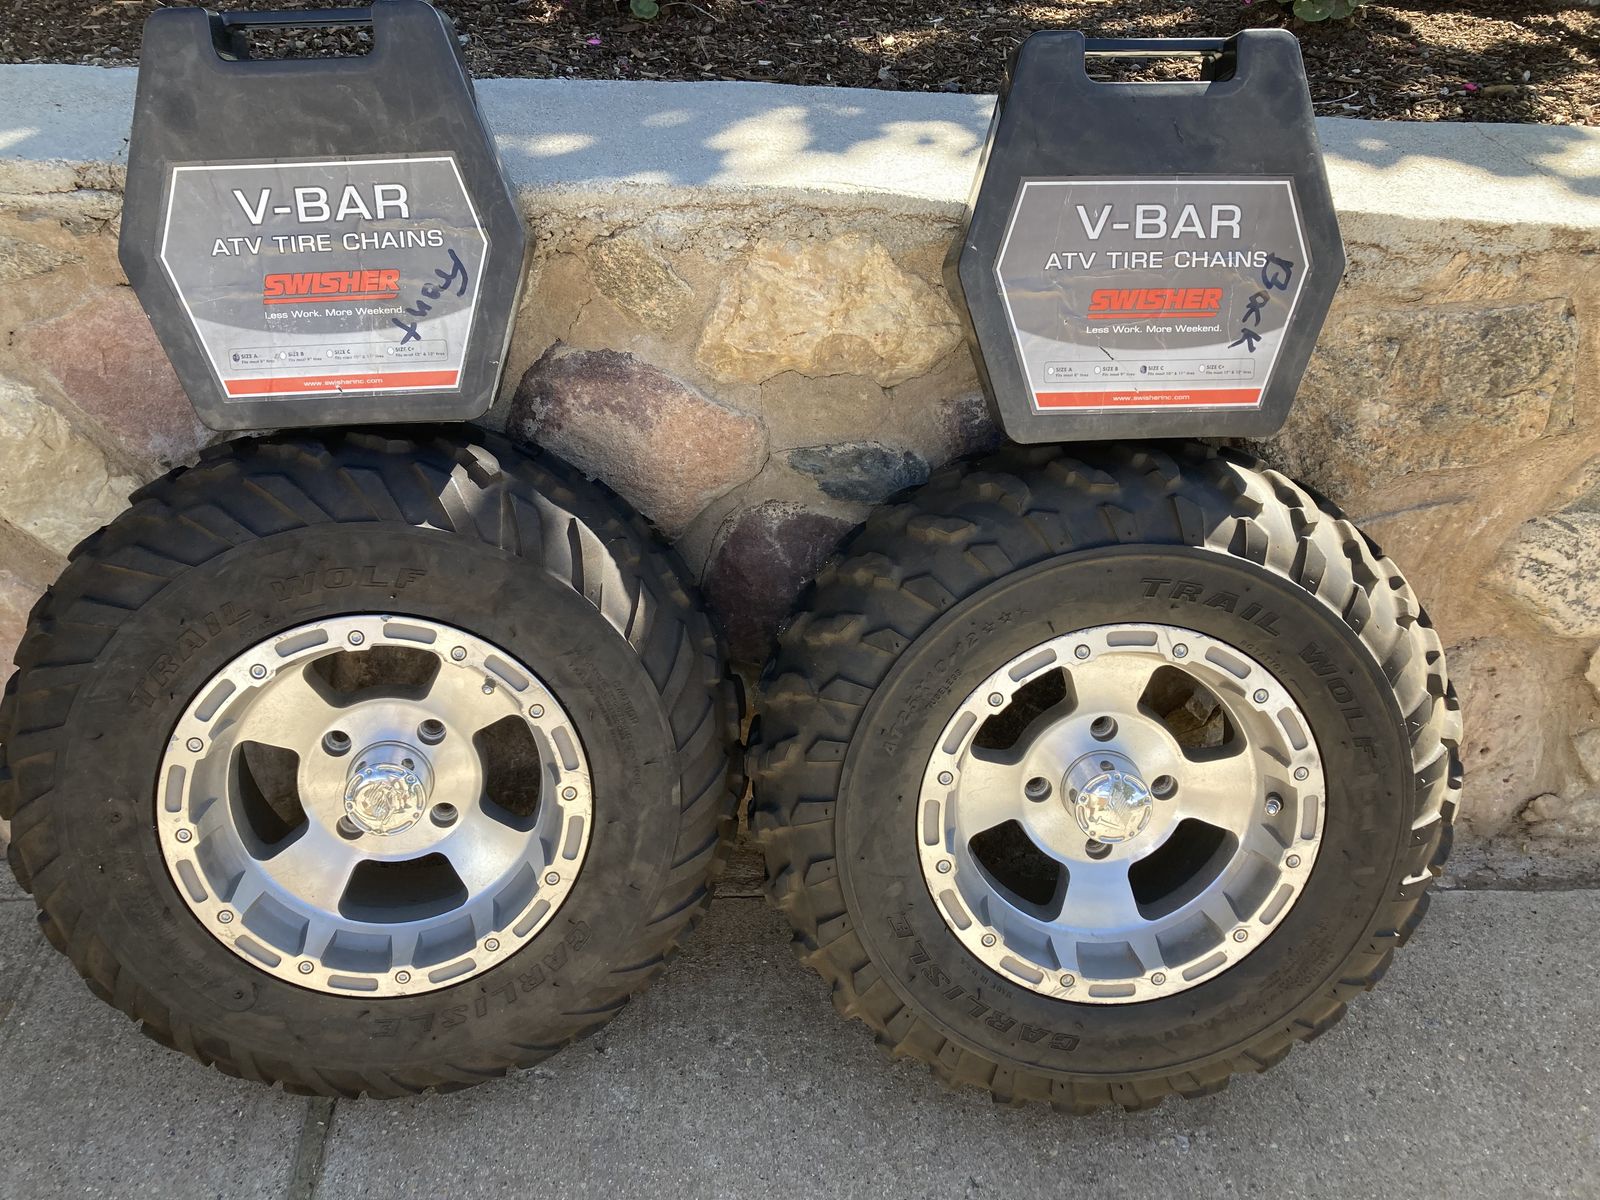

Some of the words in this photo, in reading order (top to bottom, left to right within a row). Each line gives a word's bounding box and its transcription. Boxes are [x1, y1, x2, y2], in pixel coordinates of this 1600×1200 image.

[233, 183, 410, 225] V-BAR
[1076, 204, 1243, 240] V-BAR
[211, 236, 262, 257] ATV
[272, 233, 332, 254] TIRE
[342, 229, 444, 251] CHAINS
[1044, 252, 1096, 270] ATV
[1106, 251, 1163, 269] TIRE
[1174, 250, 1268, 269] CHAINS
[263, 269, 401, 297] SWISHER
[264, 311, 289, 320] Less
[290, 309, 322, 318] Work.
[325, 308, 353, 317] More
[355, 305, 406, 316] Weekend.
[1087, 288, 1223, 312] SWISHER
[1086, 326, 1110, 334] Less
[1112, 325, 1143, 333] Work.
[1146, 325, 1173, 333] More
[1175, 324, 1222, 333] Weekend.
[127, 601, 252, 708] TRAIL
[270, 564, 429, 602] WOLF
[1140, 577, 1281, 637] TRAIL
[1299, 641, 1379, 760] WOLF
[887, 912, 1081, 1052] CARLISLE
